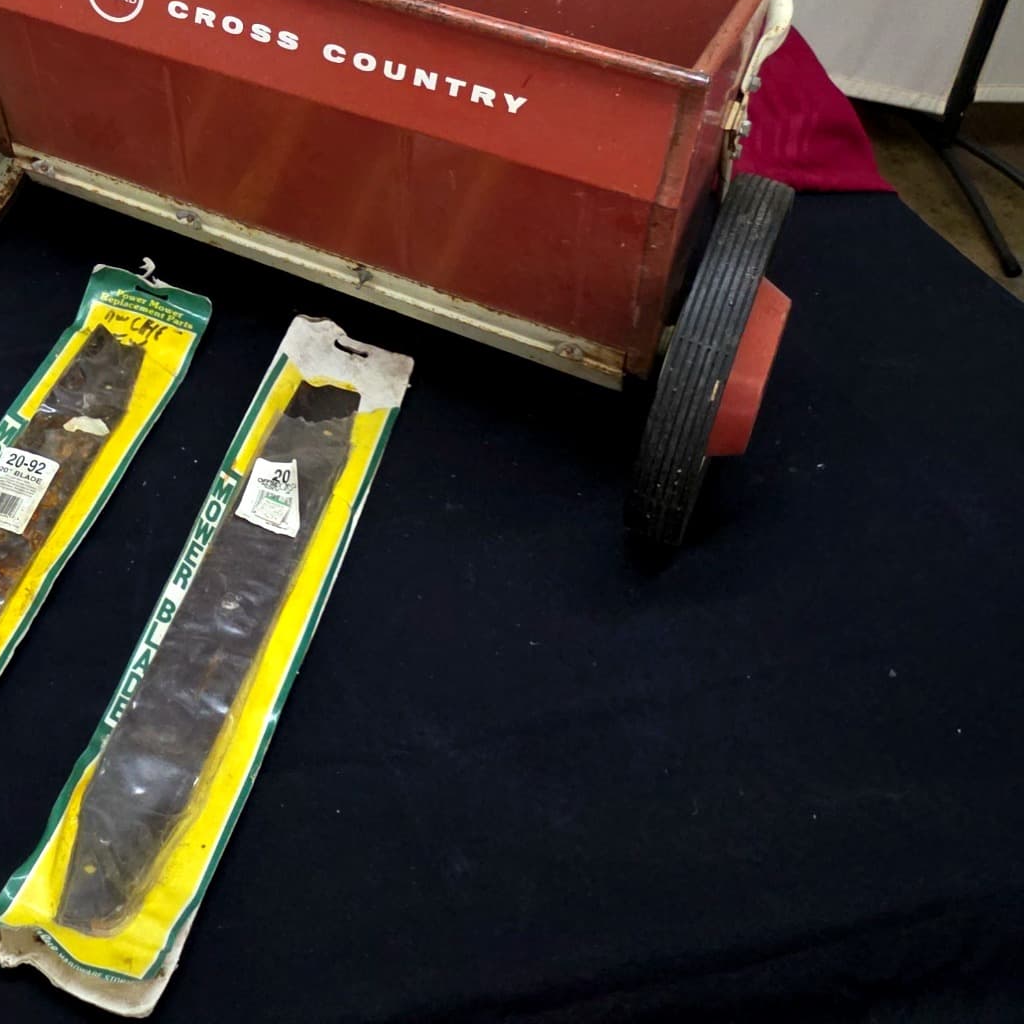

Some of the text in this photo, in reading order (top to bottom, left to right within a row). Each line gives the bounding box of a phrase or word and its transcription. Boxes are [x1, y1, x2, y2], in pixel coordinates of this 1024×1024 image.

[167, 0, 527, 114] CROSS COUNTRY
[100, 291, 166, 319] Replacement
[167, 315, 193, 329] Parts
[115, 289, 147, 304] Power
[149, 299, 184, 318] Mower
[6, 453, 46, 475] 20-92
[14, 470, 43, 485] BLADE
[172, 482, 232, 591] MOWER
